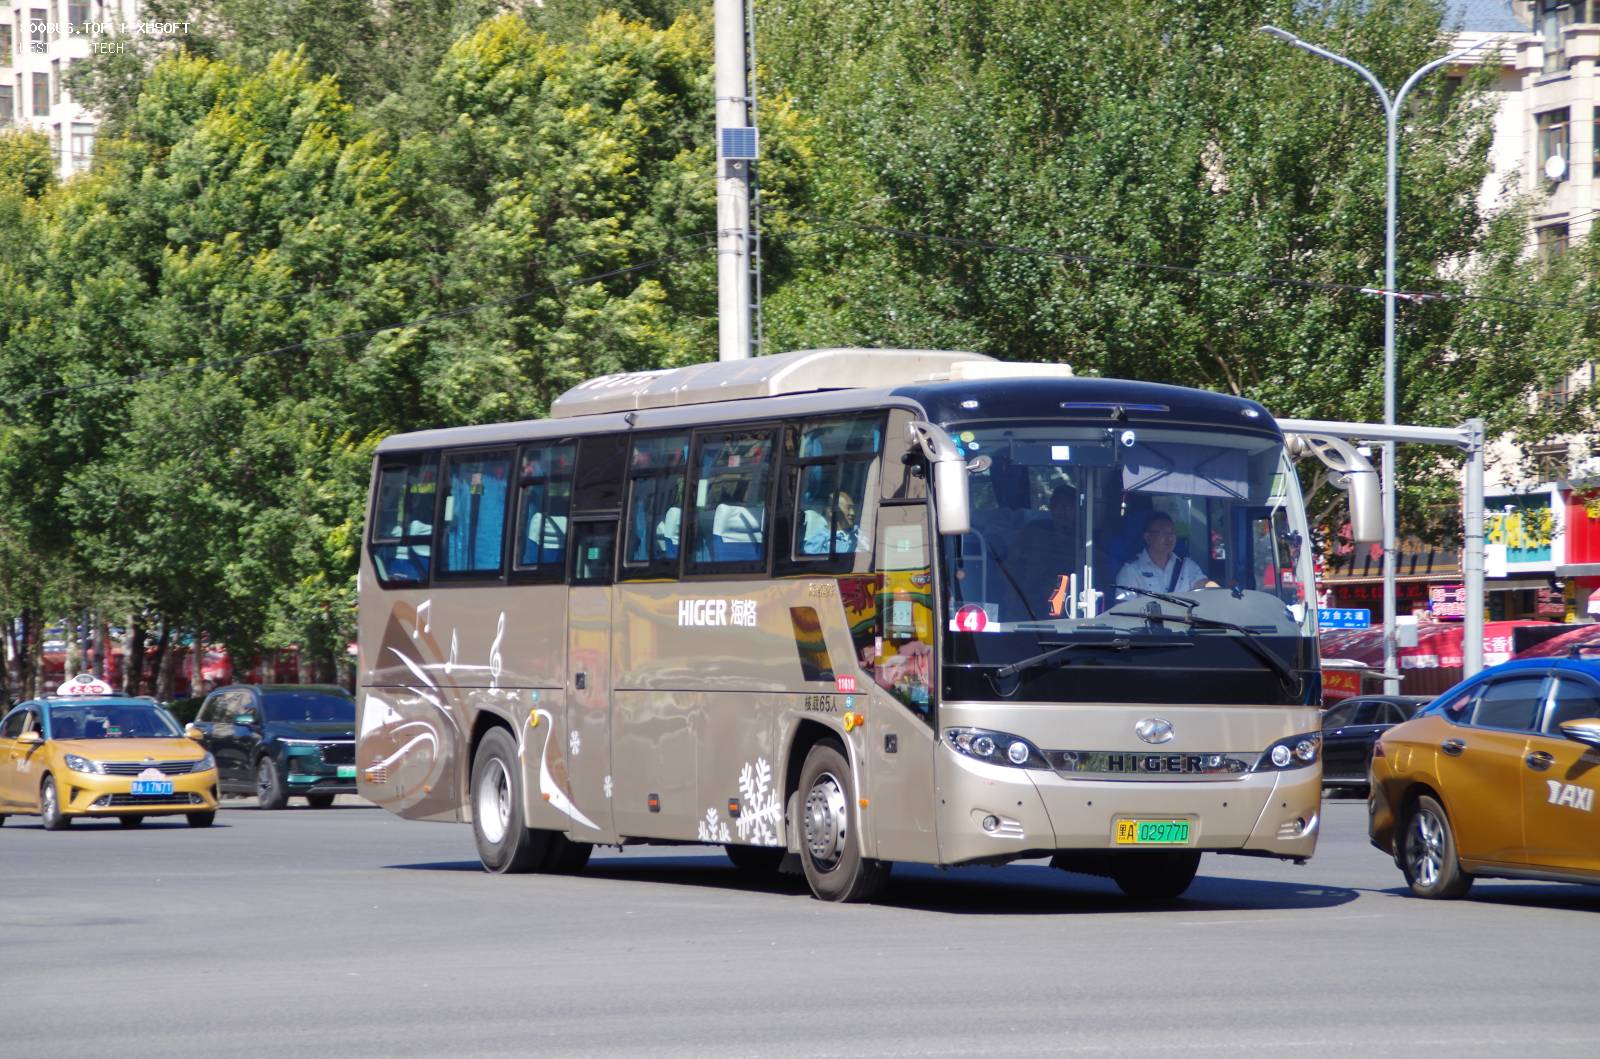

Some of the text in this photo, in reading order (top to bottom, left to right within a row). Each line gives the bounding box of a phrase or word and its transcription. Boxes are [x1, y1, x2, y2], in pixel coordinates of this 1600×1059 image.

[678, 599, 757, 627] HIGER 海格
[963, 609, 978, 631] 4
[804, 695, 838, 712] 核载65人
[1108, 755, 1202, 772] HIGER
[1546, 779, 1595, 812] TAXI
